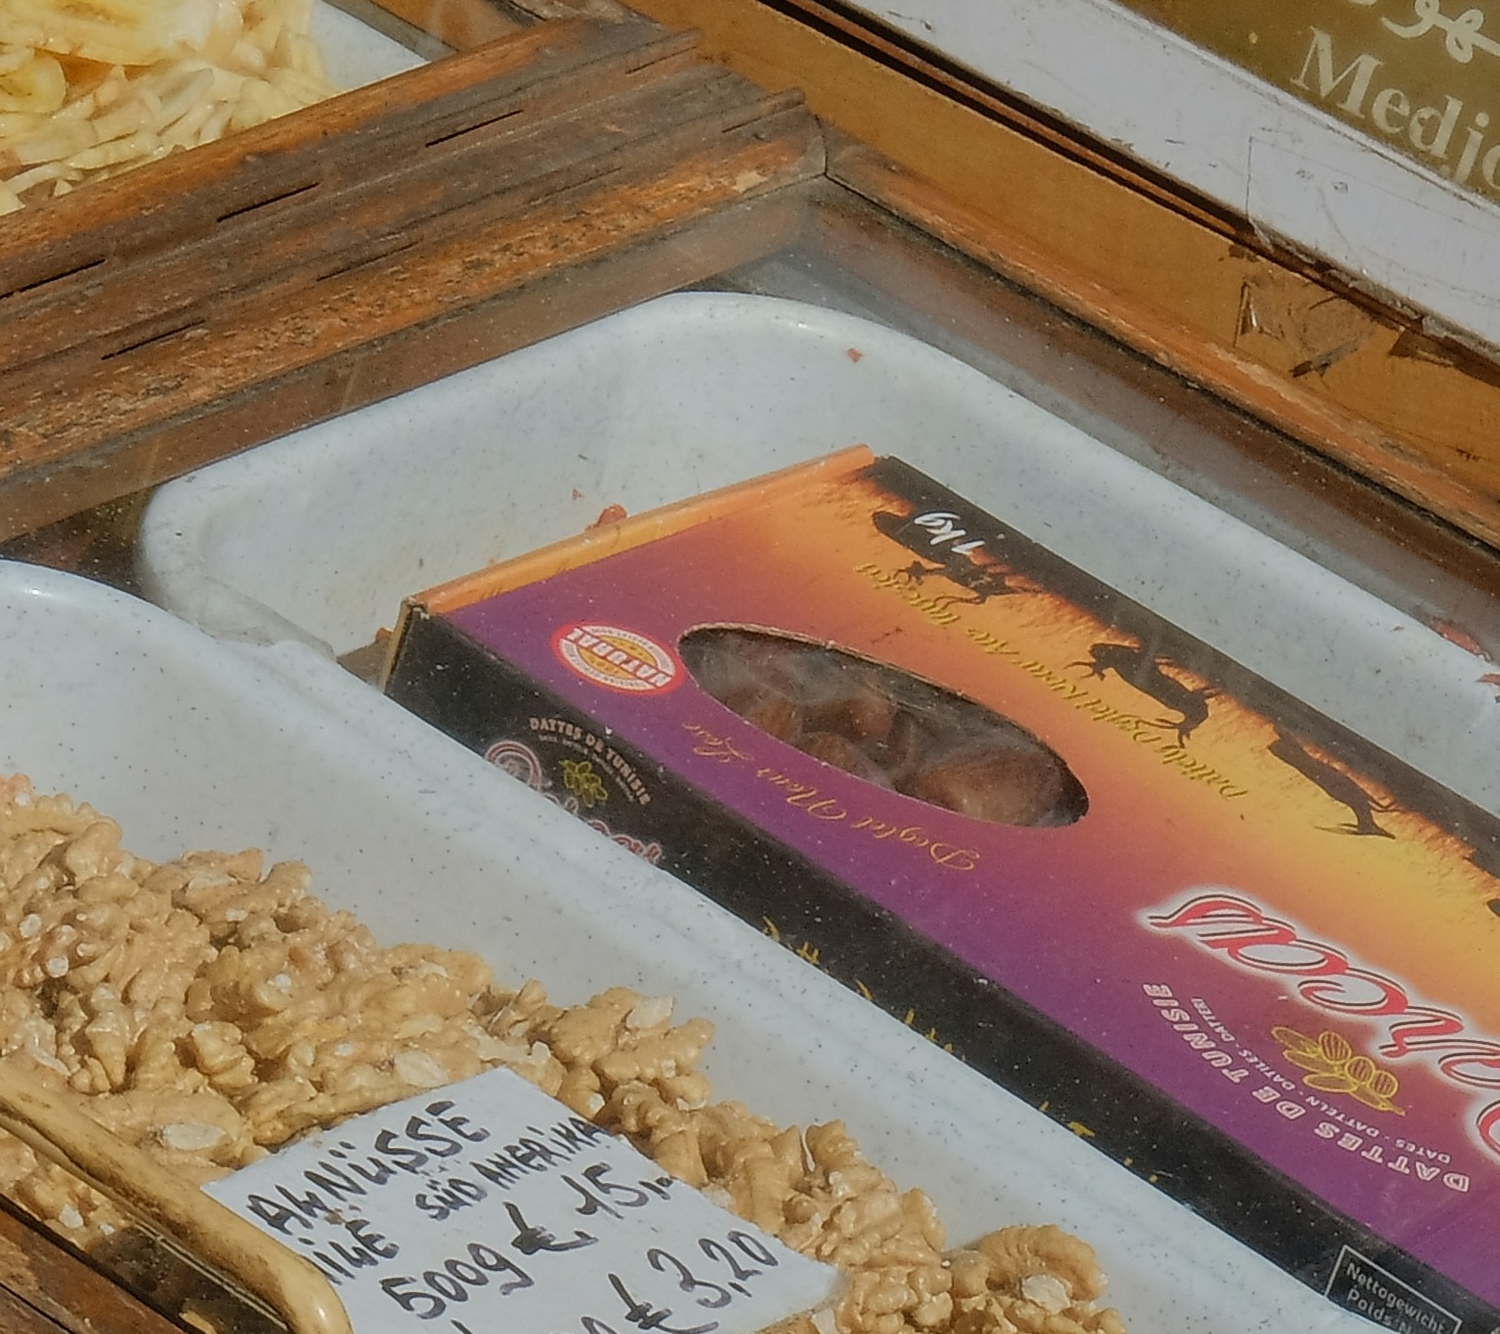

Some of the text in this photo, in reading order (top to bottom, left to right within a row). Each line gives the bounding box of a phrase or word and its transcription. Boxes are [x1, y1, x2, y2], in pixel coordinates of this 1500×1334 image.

[1141, 982, 1471, 1193] DATTES DE TUNISIE
[1146, 891, 1500, 1167] orcas
[245, 1100, 492, 1237] ALNÜSSE
[379, 1241, 536, 1321] 500g
[503, 1201, 600, 1256] €
[607, 1272, 720, 1334] €
